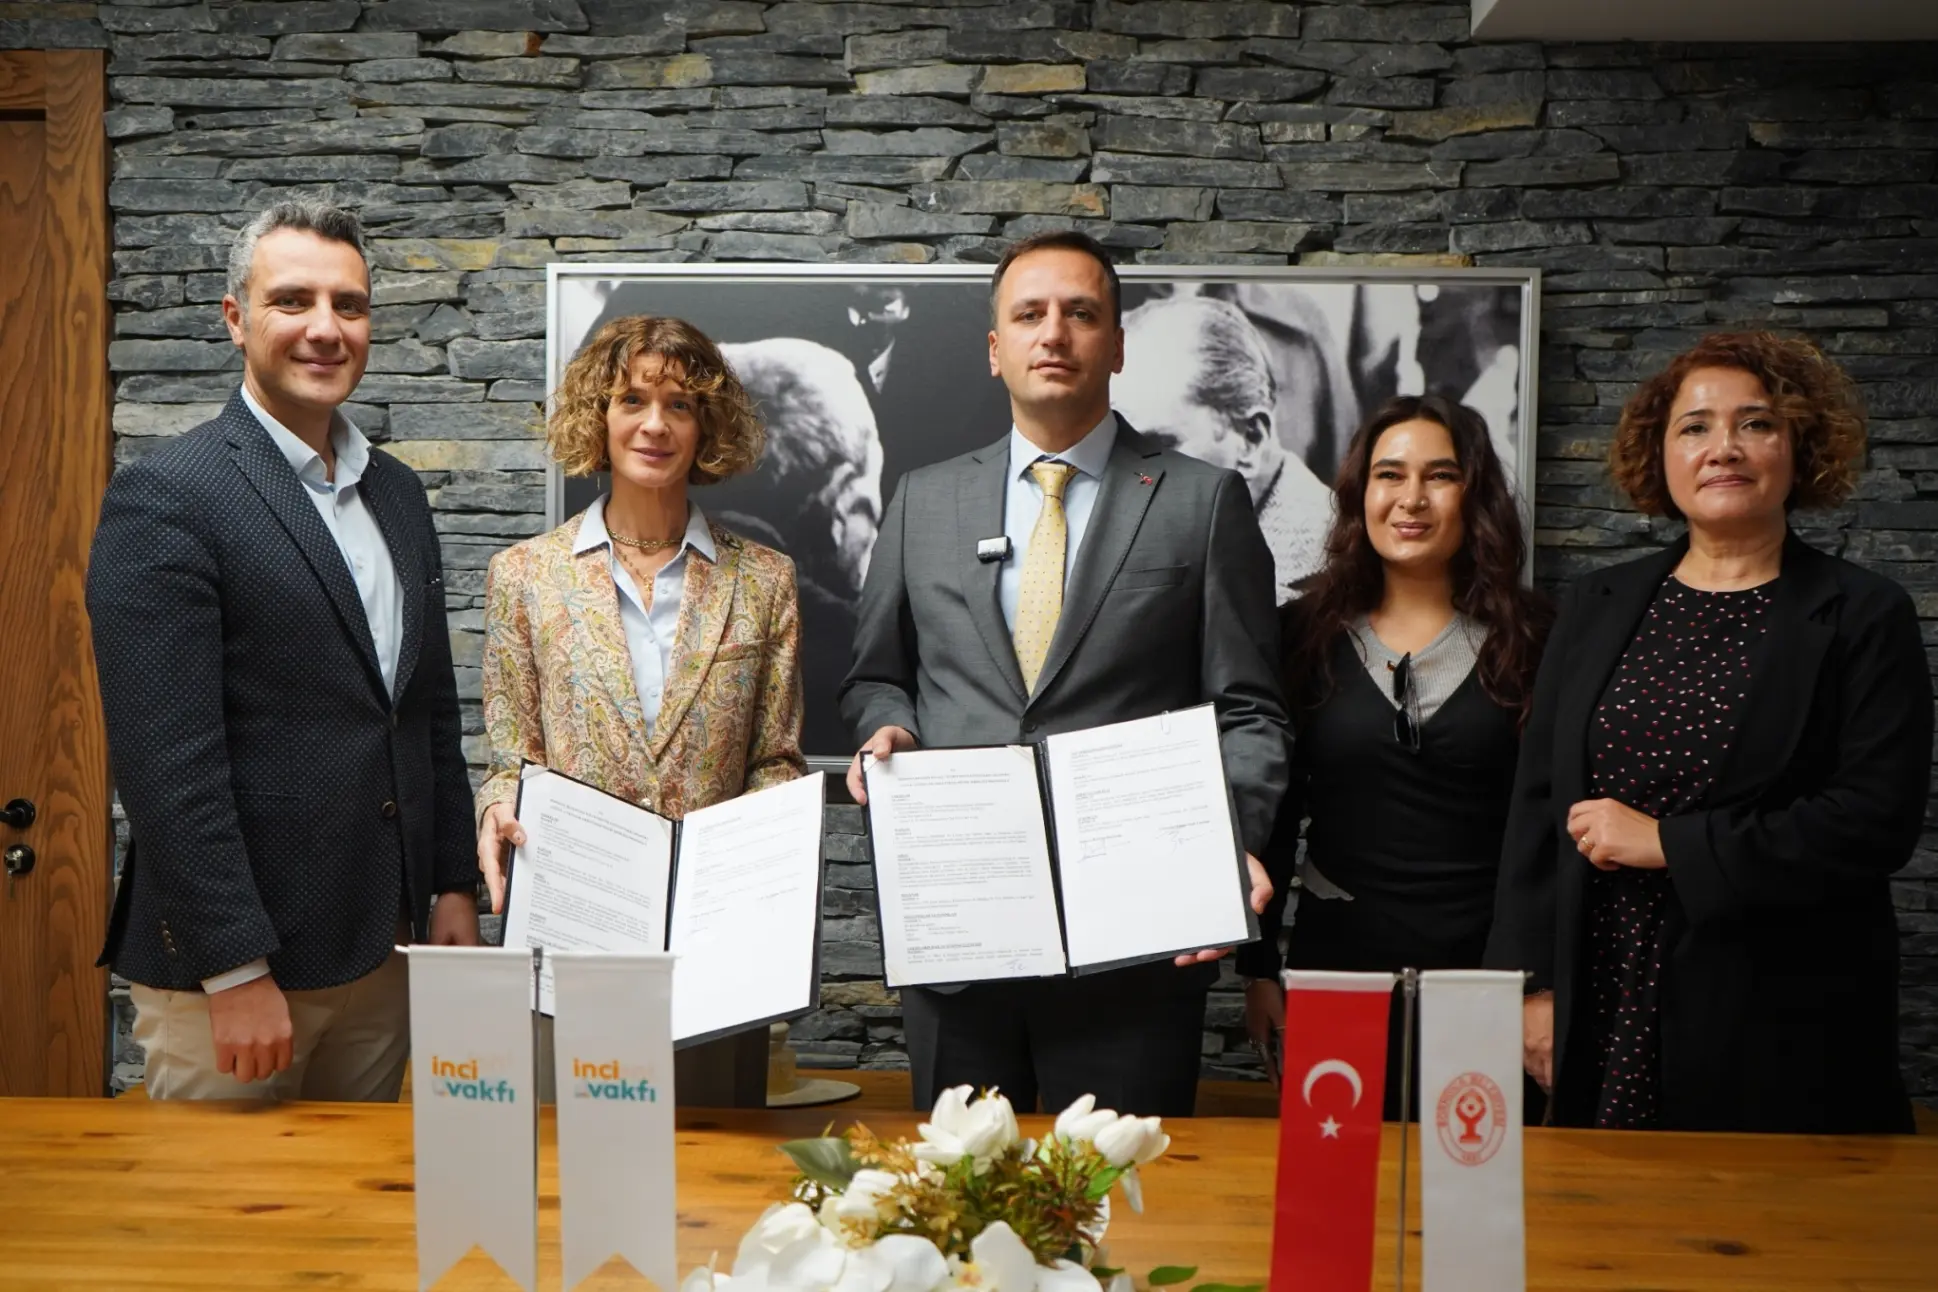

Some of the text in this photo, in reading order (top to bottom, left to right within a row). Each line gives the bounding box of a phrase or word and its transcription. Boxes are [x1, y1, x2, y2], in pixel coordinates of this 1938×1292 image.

[432, 1055, 478, 1080] inci
[573, 1057, 620, 1080] inci
[446, 1080, 515, 1103] vakfı
[588, 1079, 656, 1103] vakfı
